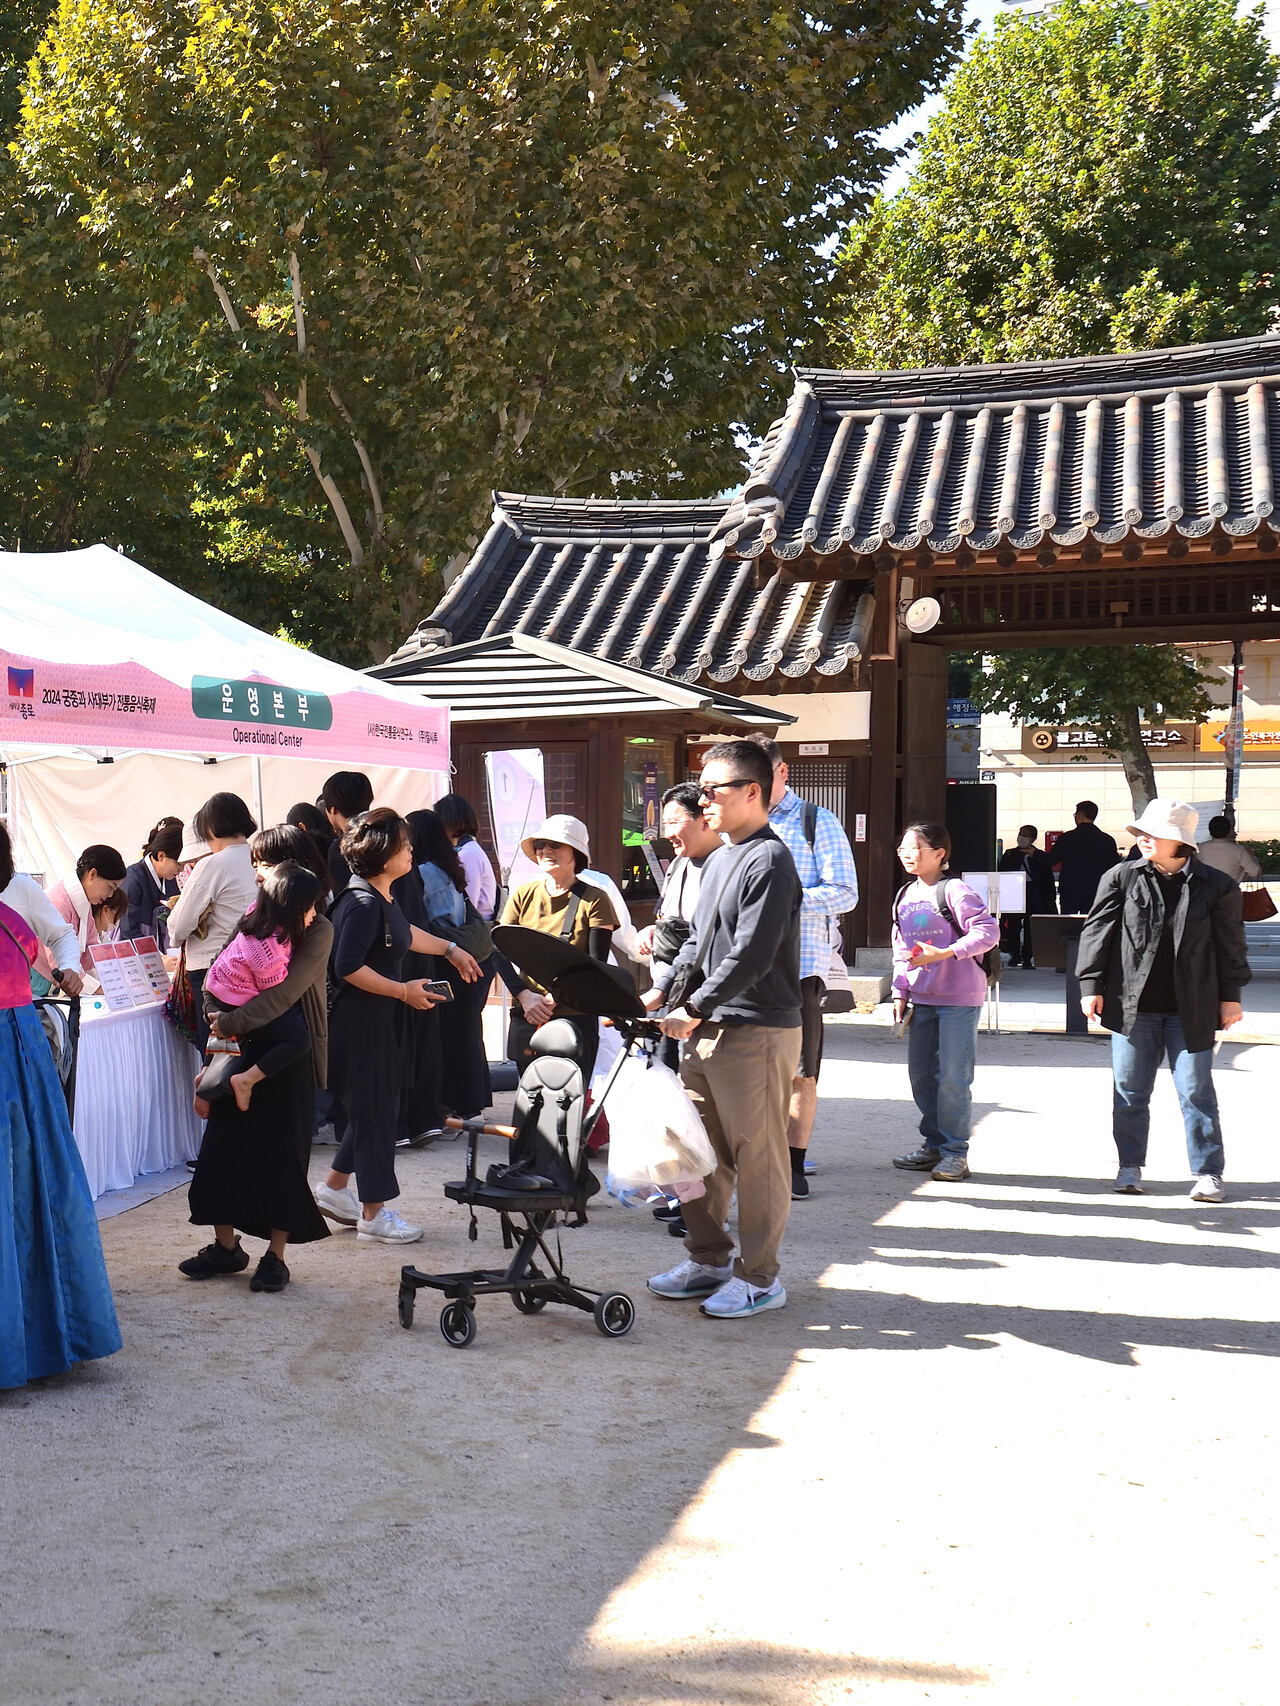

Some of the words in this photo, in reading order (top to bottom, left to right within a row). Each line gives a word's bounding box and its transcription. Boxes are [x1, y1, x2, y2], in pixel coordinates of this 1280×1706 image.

[20, 703, 36, 720] 종로
[42, 688, 61, 704] 2024
[62, 689, 86, 709] 궁중과
[87, 691, 116, 711] 사대부가
[117, 694, 157, 715] 전통음식축제
[221, 683, 310, 722] 운영본부
[232, 727, 278, 746] Operational
[278, 731, 303, 748] Center
